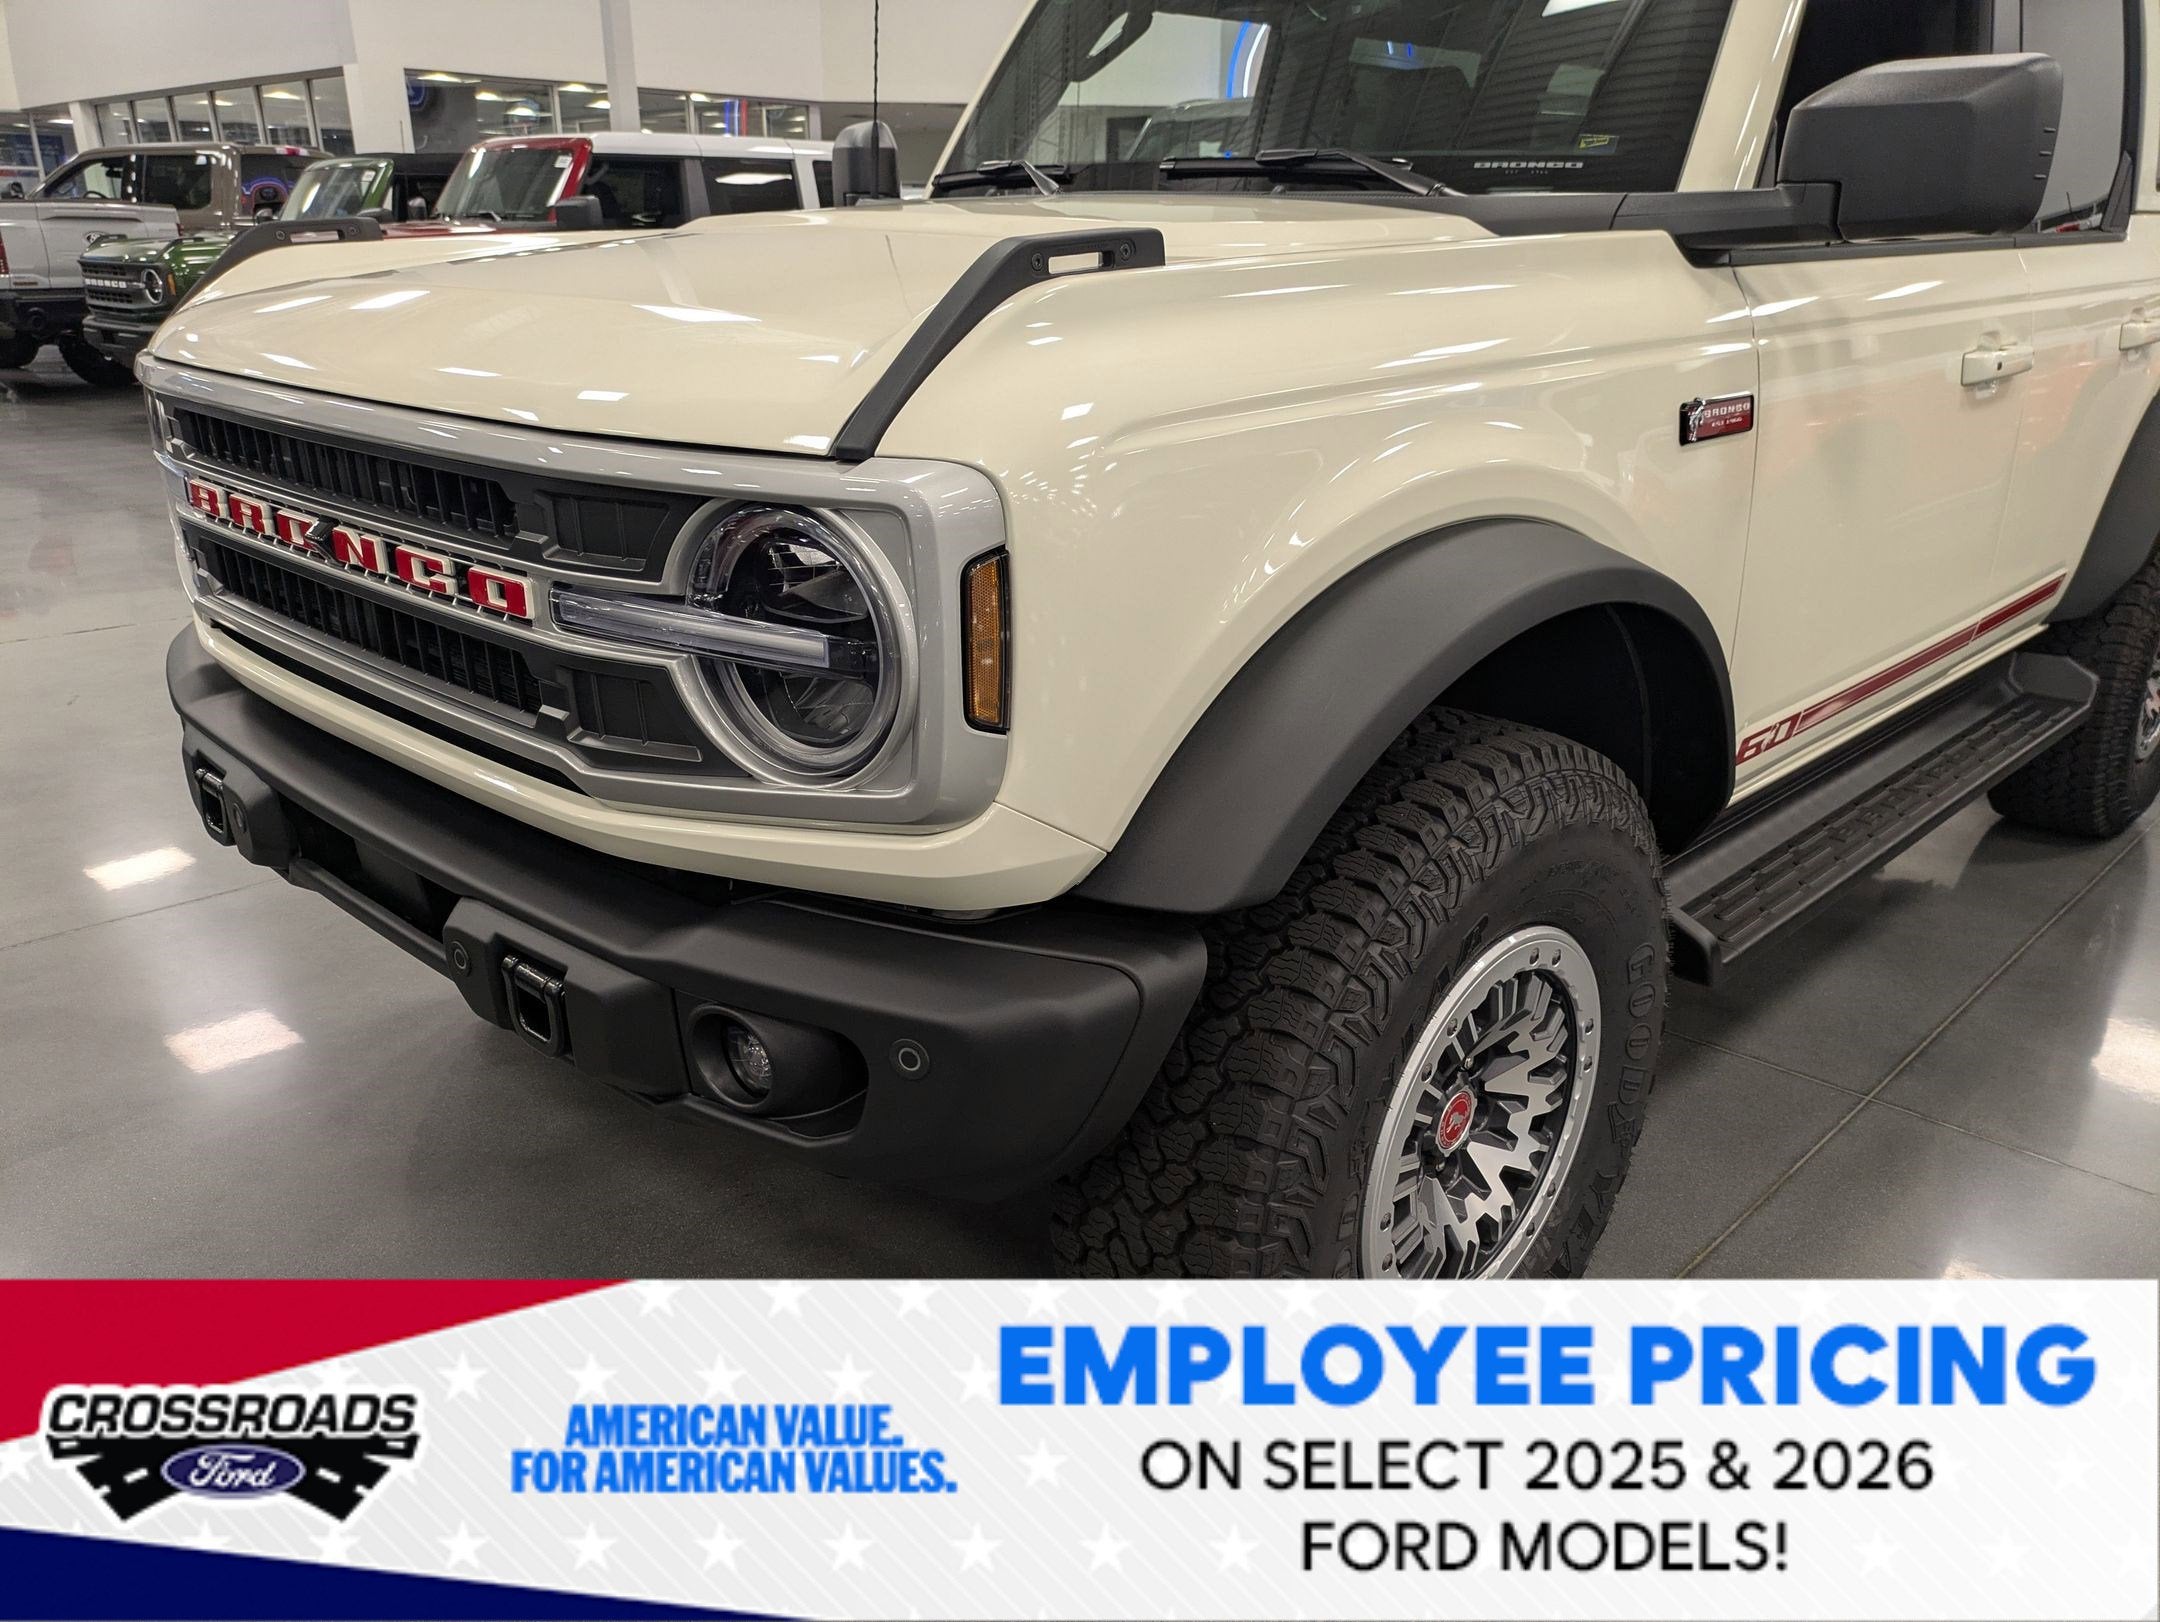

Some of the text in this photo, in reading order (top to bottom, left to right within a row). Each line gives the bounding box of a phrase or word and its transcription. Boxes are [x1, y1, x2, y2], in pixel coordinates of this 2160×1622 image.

[1473, 161, 1584, 169] BRONCO
[1704, 402, 1750, 417] BRONCO
[188, 476, 537, 620] BRONCO
[1735, 711, 1802, 766] 60
